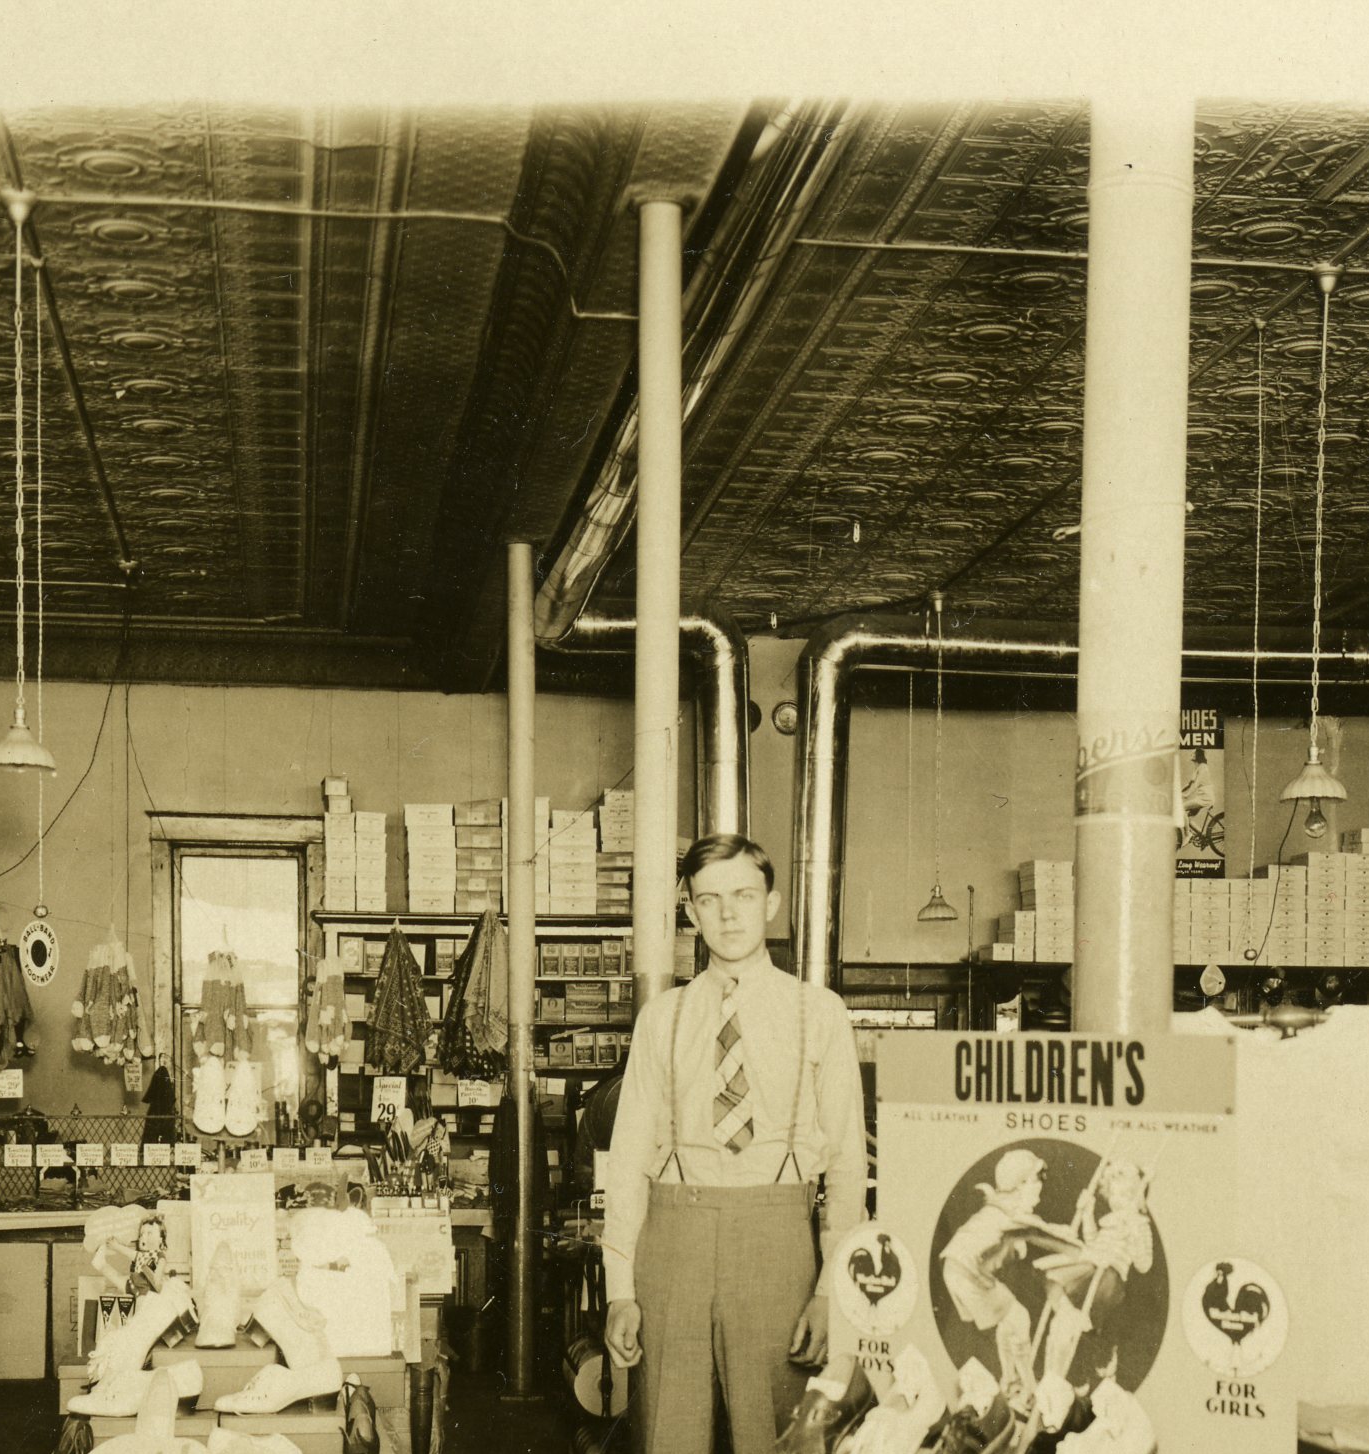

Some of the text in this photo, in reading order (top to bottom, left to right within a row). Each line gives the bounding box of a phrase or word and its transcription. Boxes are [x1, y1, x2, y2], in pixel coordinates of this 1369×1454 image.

[1182, 709, 1217, 730] HOES
[24, 964, 56, 984] FOOTWEAR
[954, 1039, 1145, 1107] CHILDREN'S
[376, 1078, 403, 1092] Special
[903, 1112, 979, 1123] ALL LEATHER
[1006, 1112, 1087, 1132] SHOES
[1109, 1120, 1219, 1134] FOR ALL WEATHER
[210, 1210, 259, 1232] Quality
[858, 1338, 890, 1355] FOR
[855, 1355, 895, 1373] OYS
[1216, 1380, 1257, 1399] FOR
[1206, 1398, 1266, 1418] GIRLS
